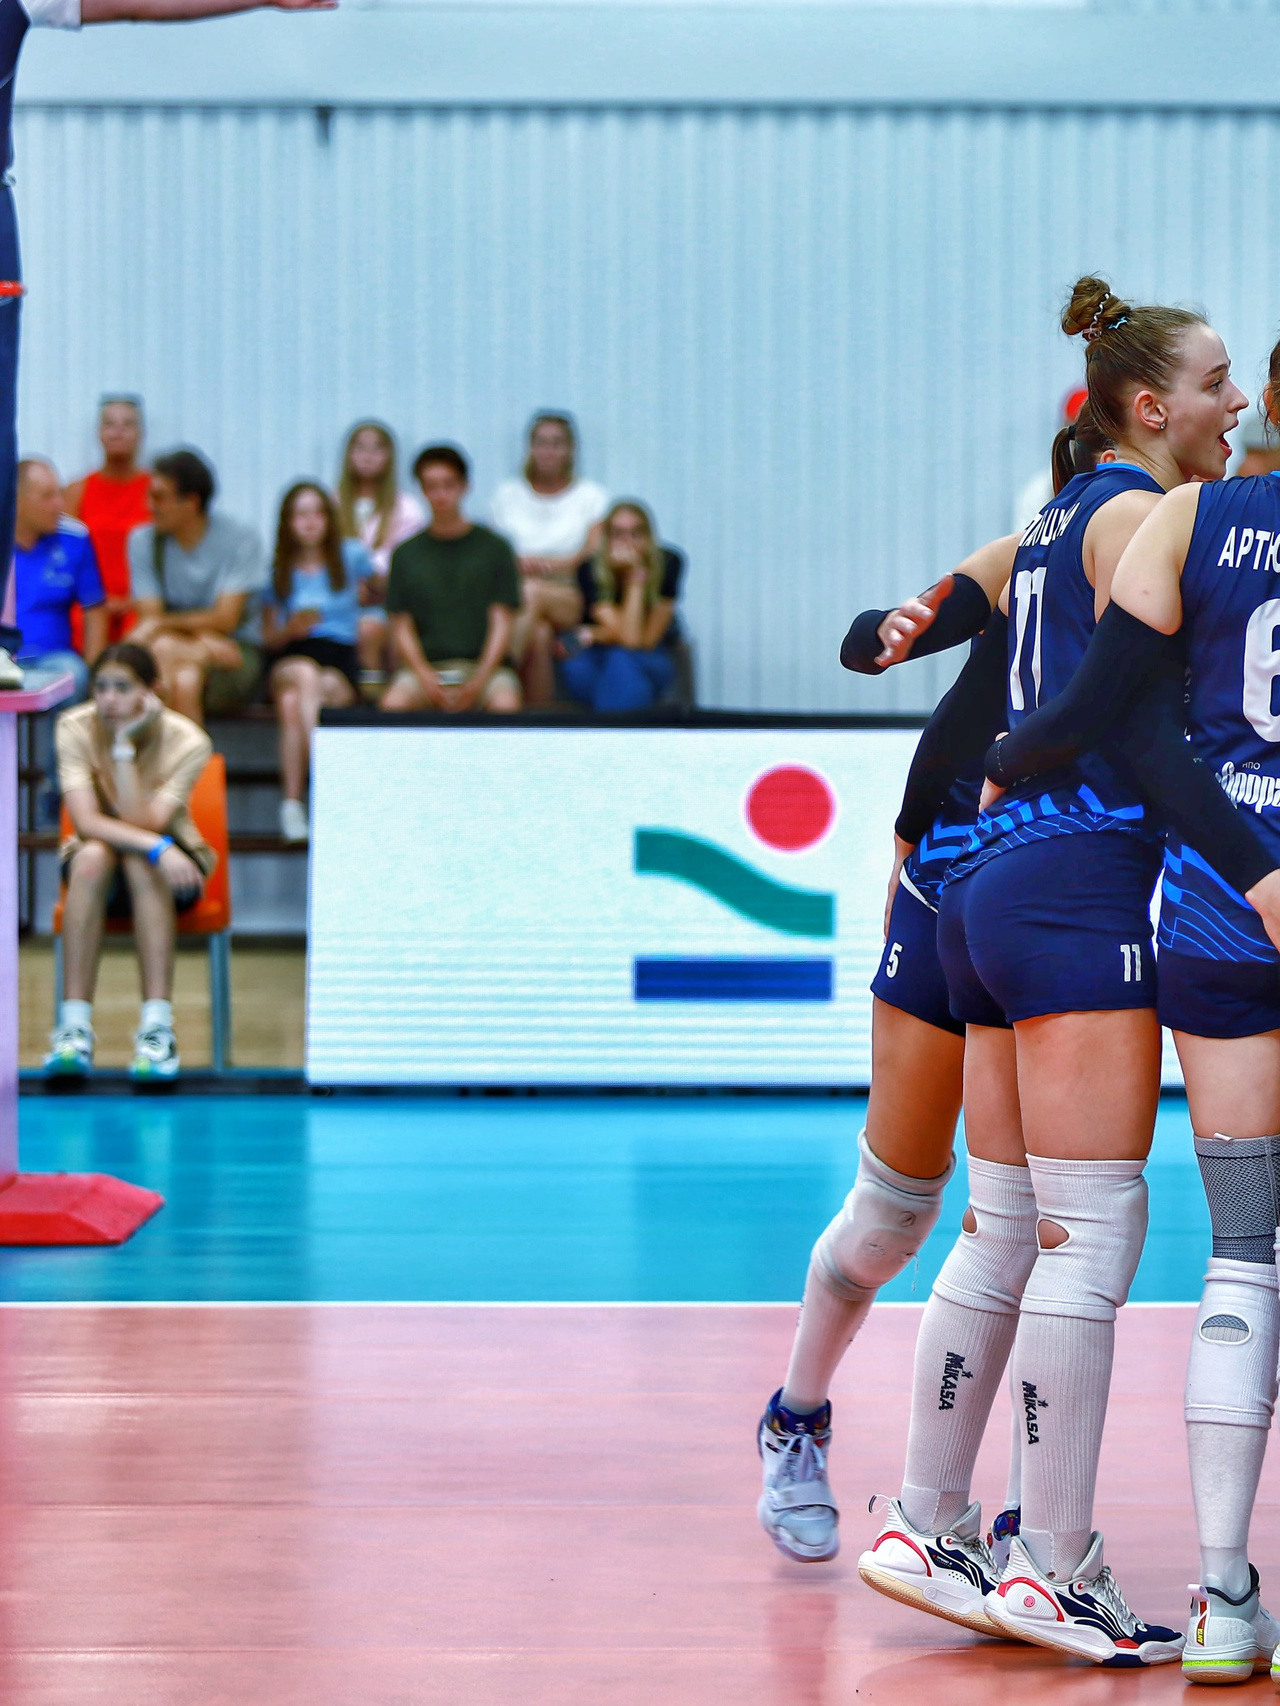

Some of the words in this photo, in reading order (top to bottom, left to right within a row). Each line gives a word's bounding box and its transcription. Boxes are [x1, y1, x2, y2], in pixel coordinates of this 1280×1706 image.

[1010, 566, 1048, 711] 11
[885, 941, 903, 979] 5
[1119, 943, 1142, 982] 11
[938, 1351, 970, 1411] MIKASA
[1021, 1380, 1043, 1445] MIKASA
